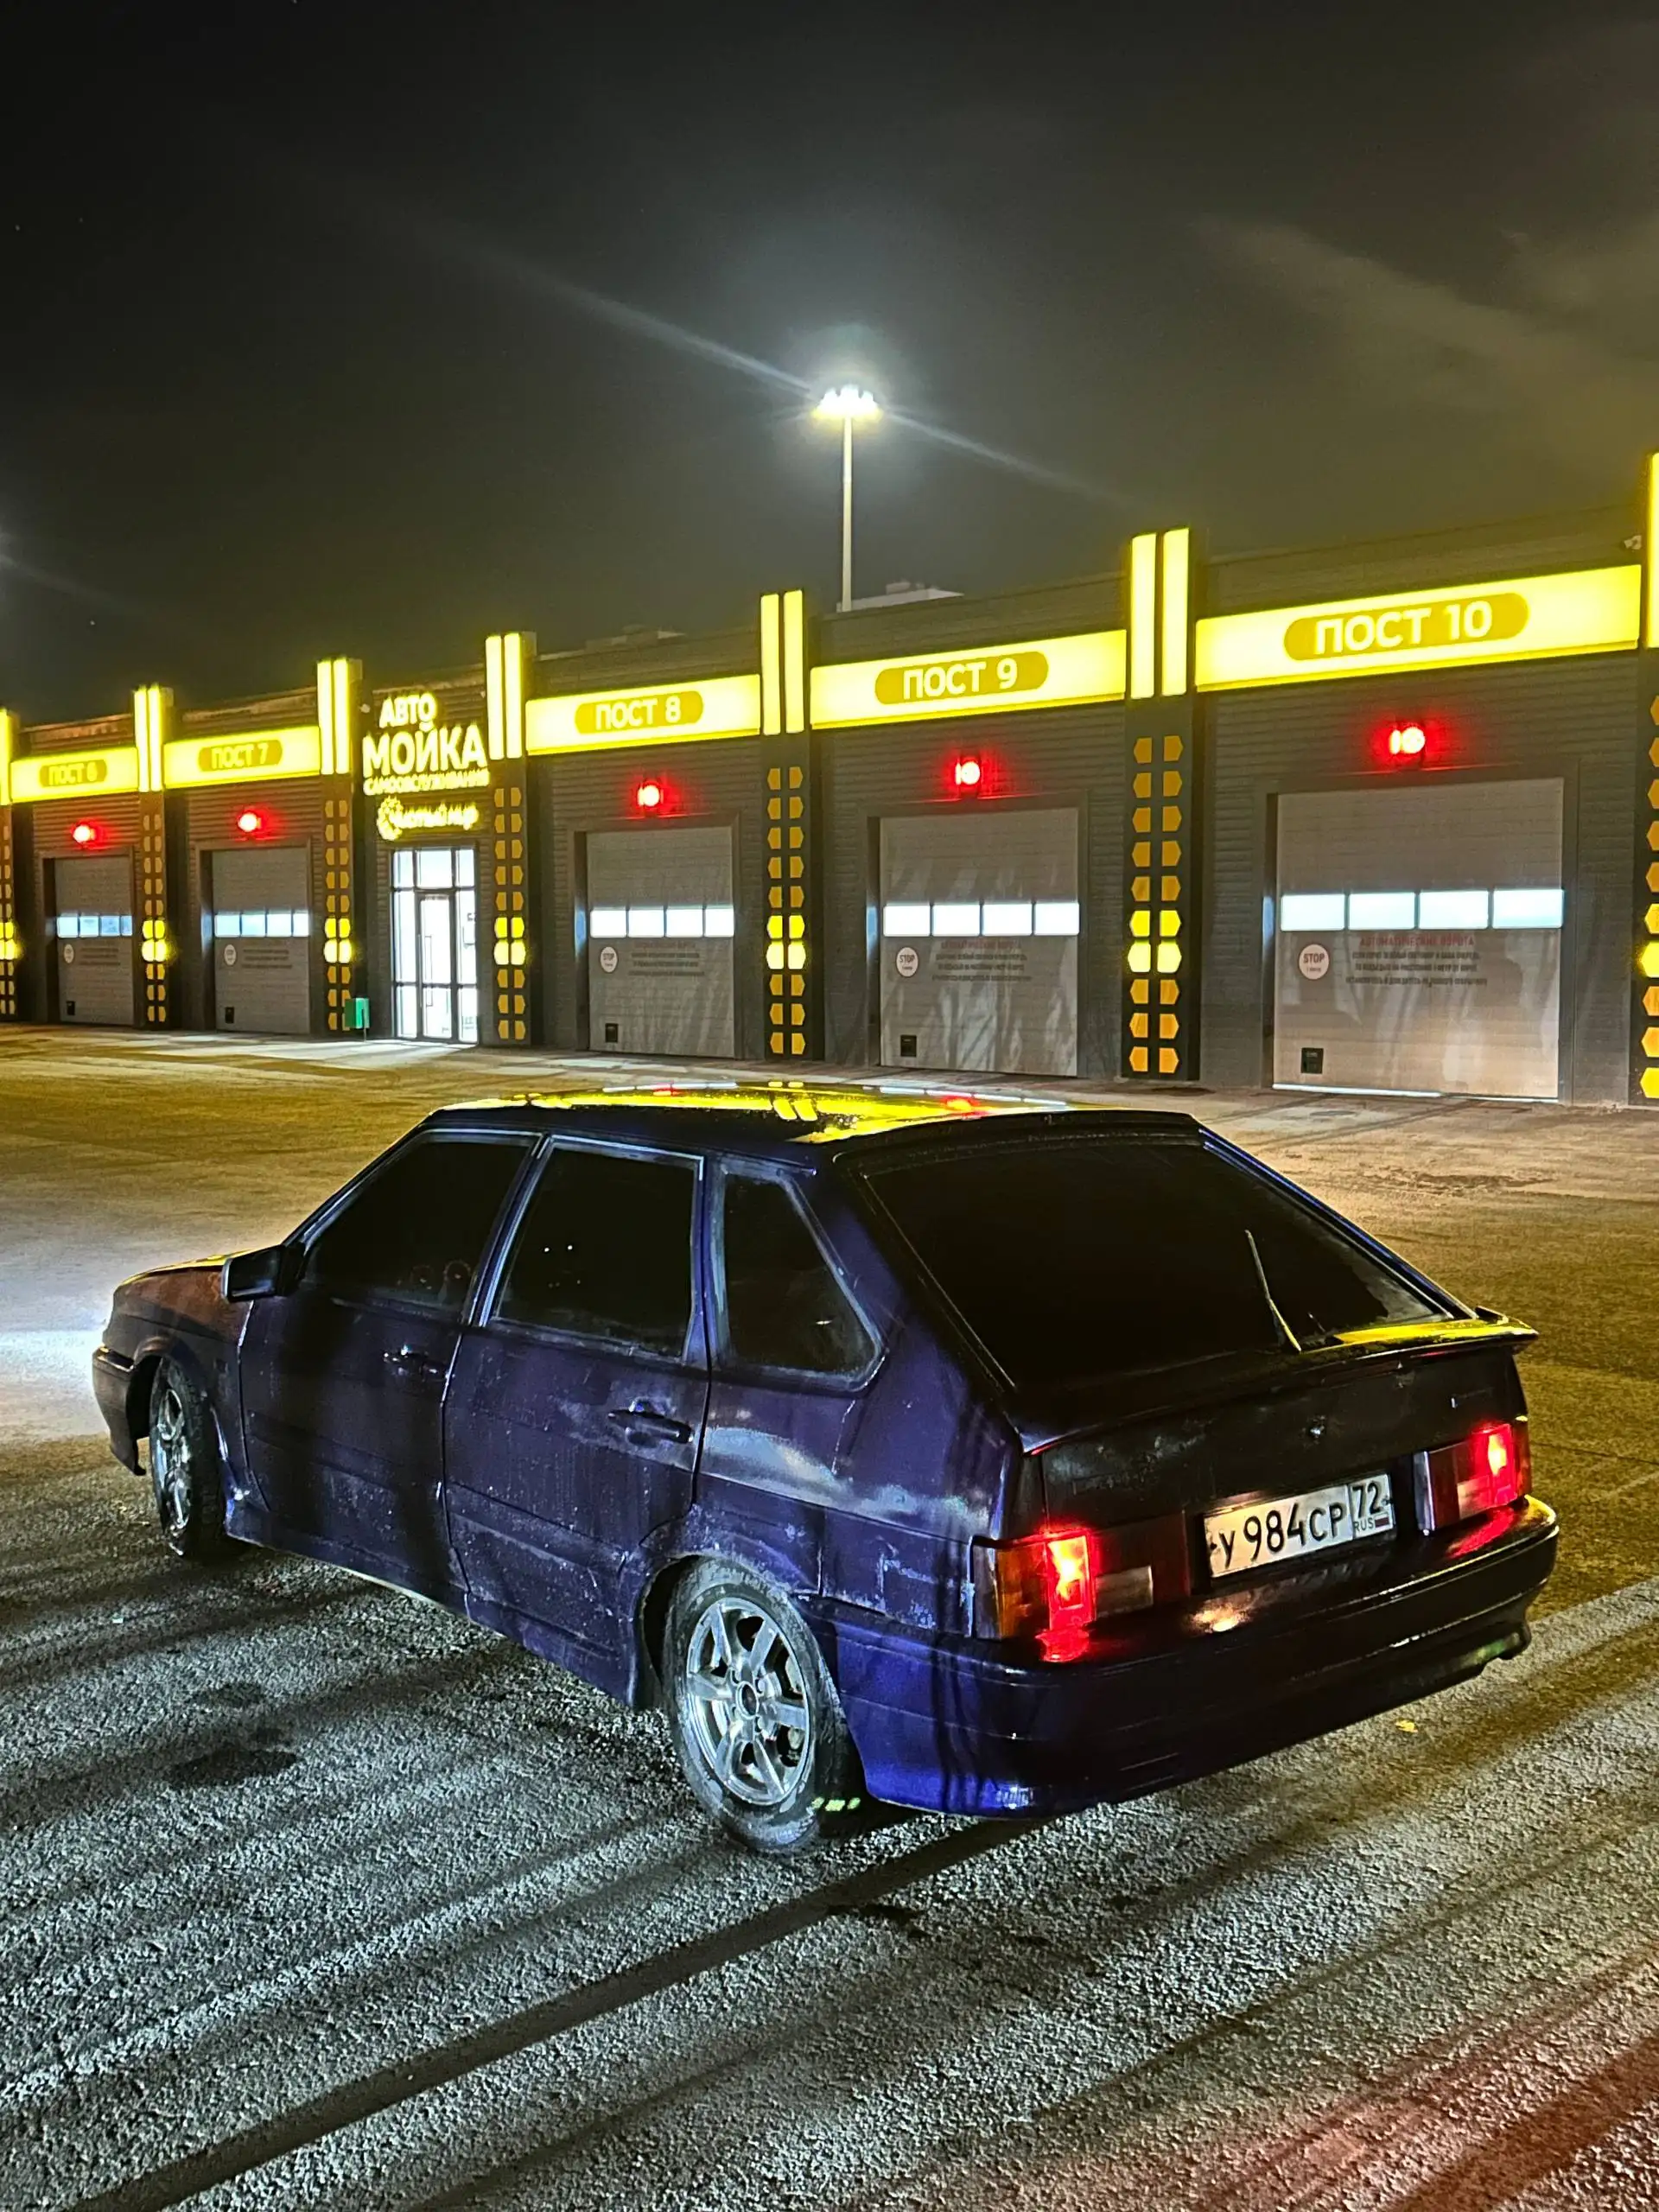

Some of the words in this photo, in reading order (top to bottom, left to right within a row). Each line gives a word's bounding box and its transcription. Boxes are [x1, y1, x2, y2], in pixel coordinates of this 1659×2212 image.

[1313, 607, 1432, 655] ПОСТ
[1443, 601, 1493, 640] 10
[903, 661, 987, 700] ПОСТ
[996, 657, 1018, 690] 9
[378, 692, 437, 729] АВТО
[595, 698, 658, 731] ПОСТ
[664, 695, 682, 724] 8
[210, 742, 255, 770] ПОСТ
[257, 742, 270, 765] 7
[362, 721, 488, 779] МОЙКА
[48, 762, 85, 785] ПОСТ
[1303, 952, 1325, 964] STOP
[1351, 1480, 1382, 1519] 72
[1353, 1517, 1376, 1533] RUS
